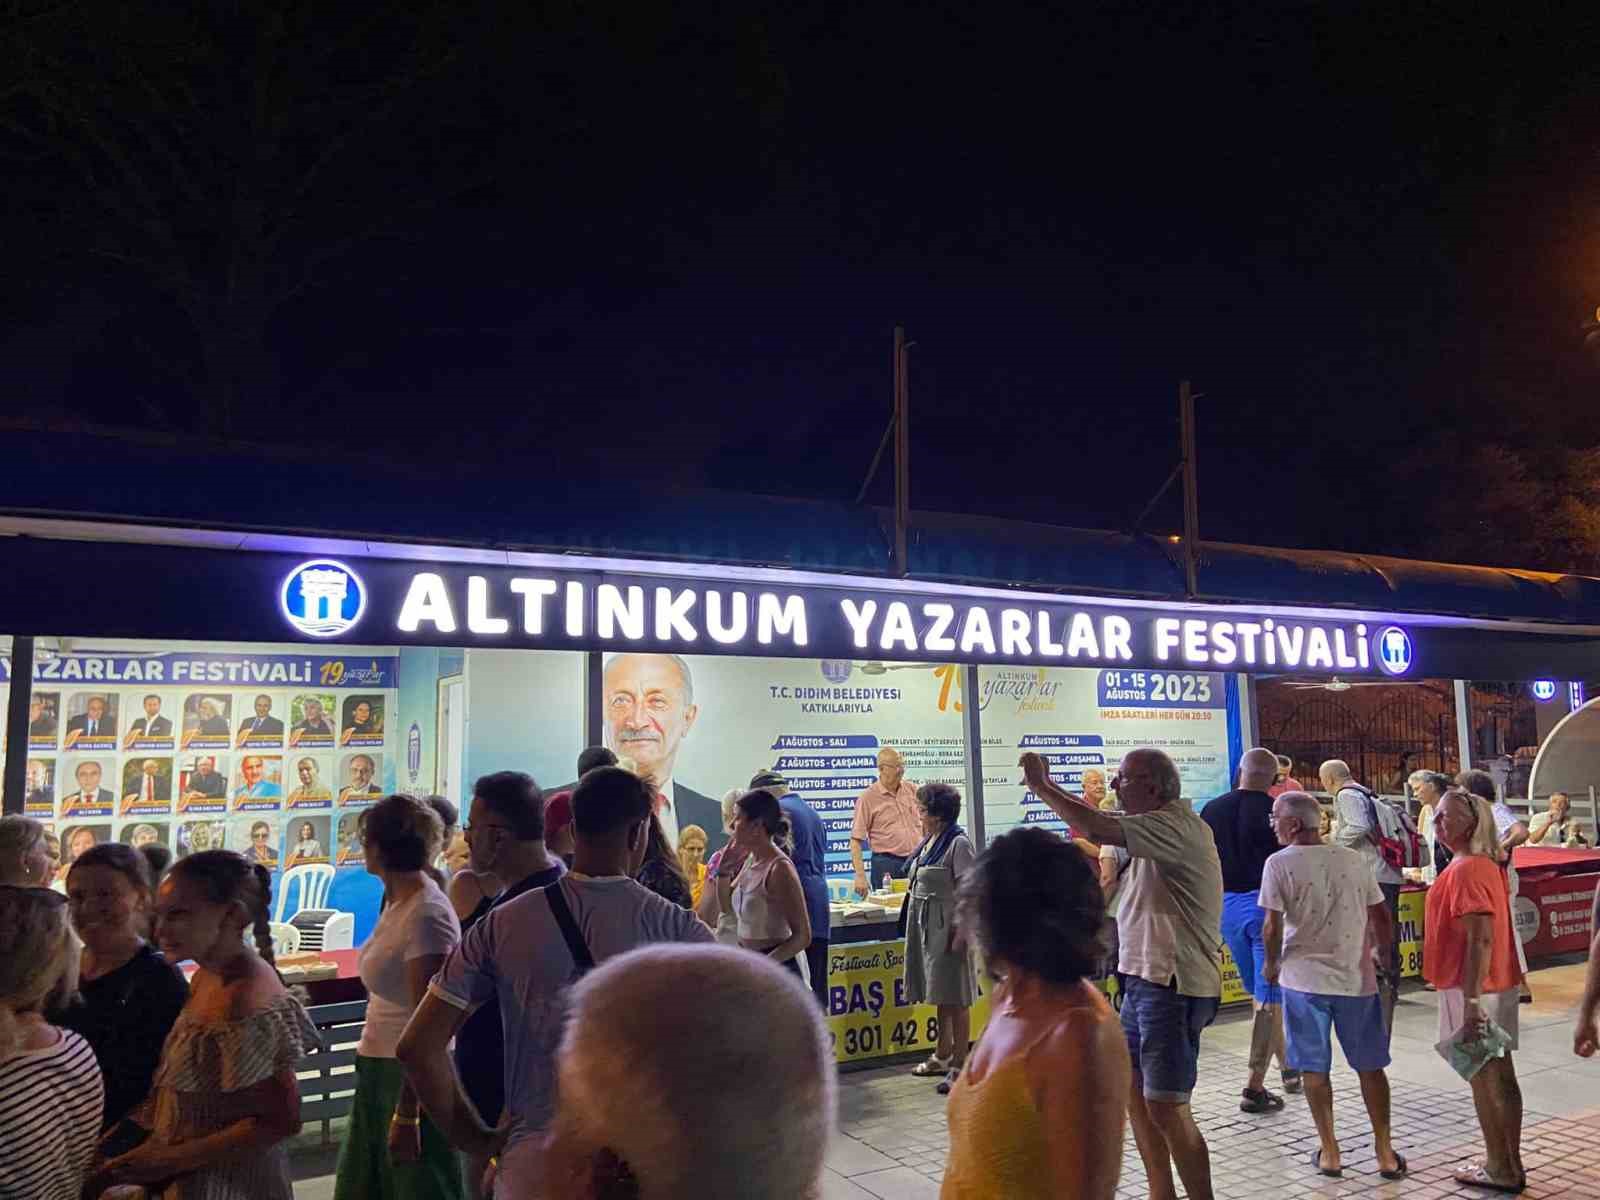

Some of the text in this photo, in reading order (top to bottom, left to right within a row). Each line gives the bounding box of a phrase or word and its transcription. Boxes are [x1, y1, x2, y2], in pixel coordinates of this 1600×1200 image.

[397, 572, 809, 646] ALTINKUM
[839, 599, 1133, 660] YAZARLAR
[320, 661, 344, 685] 19
[1105, 671, 1120, 687] 01
[1130, 672, 1146, 688] 15
[769, 686, 793, 698] T.C.
[1105, 687, 1146, 700] AĞUSTOS
[1150, 673, 1211, 702] 2023
[801, 703, 873, 713] KATKILARIYLA
[786, 736, 823, 746] AĞUSTOS
[829, 738, 847, 746] SALI
[1029, 735, 1060, 745] AĞUSTOS
[1065, 737, 1079, 745] SALI
[787, 757, 826, 768] AĞUSTOS
[831, 758, 874, 769] ÇARŞAMBA
[829, 953, 881, 975] Festivali
[845, 1024, 882, 1055] 301
[891, 1019, 919, 1046] 42
